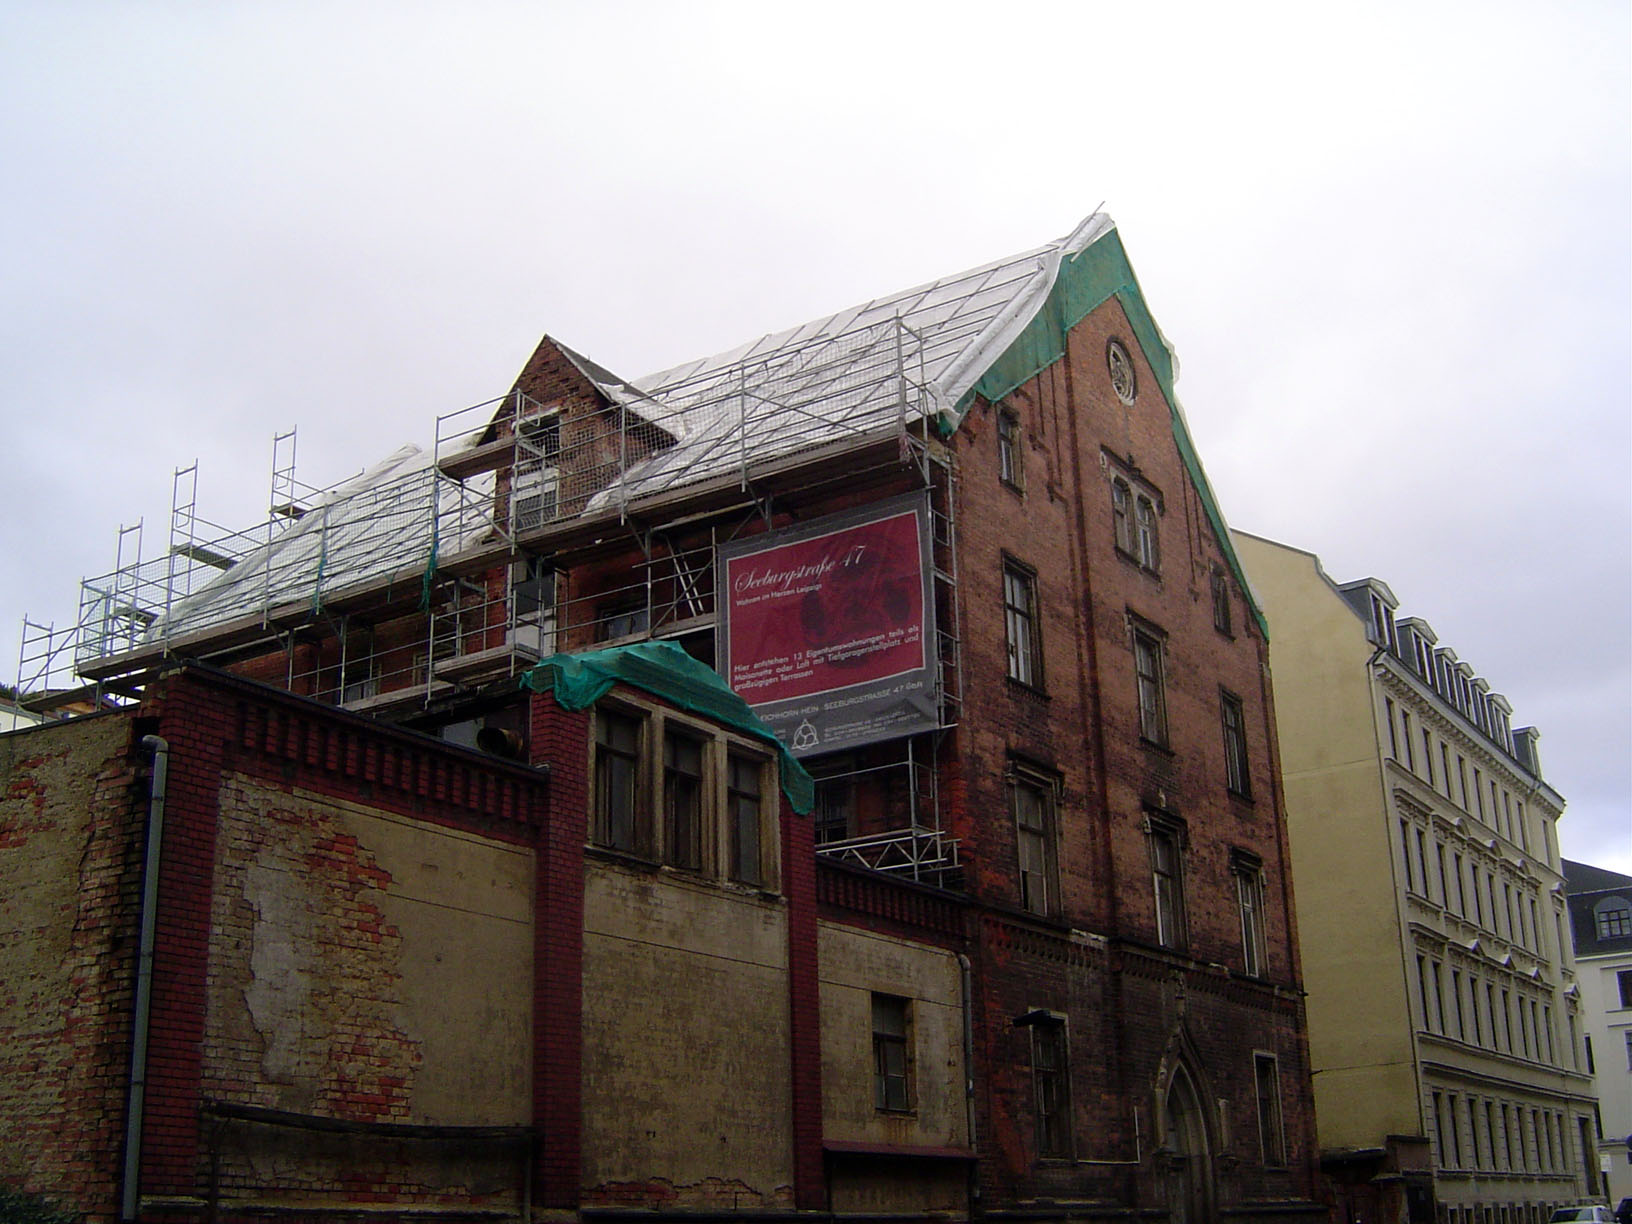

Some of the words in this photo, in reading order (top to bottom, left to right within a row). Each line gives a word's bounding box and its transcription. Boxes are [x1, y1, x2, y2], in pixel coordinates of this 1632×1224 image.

[734, 555, 836, 592] Seeburgstraße
[839, 544, 866, 568] 47
[771, 588, 796, 599] Herzen
[734, 664, 750, 673] Hier
[753, 656, 789, 669] entstehen
[806, 634, 885, 658] Eigentumswohnungen
[888, 628, 904, 639] teils
[907, 624, 919, 634] als
[734, 669, 773, 682] Maisonette
[775, 664, 793, 674] oder
[796, 659, 810, 670] Loft
[812, 656, 825, 665] mit
[828, 639, 901, 662] Tiefgaragenstellplatz
[904, 633, 919, 644] und
[780, 670, 814, 681] Terrassen
